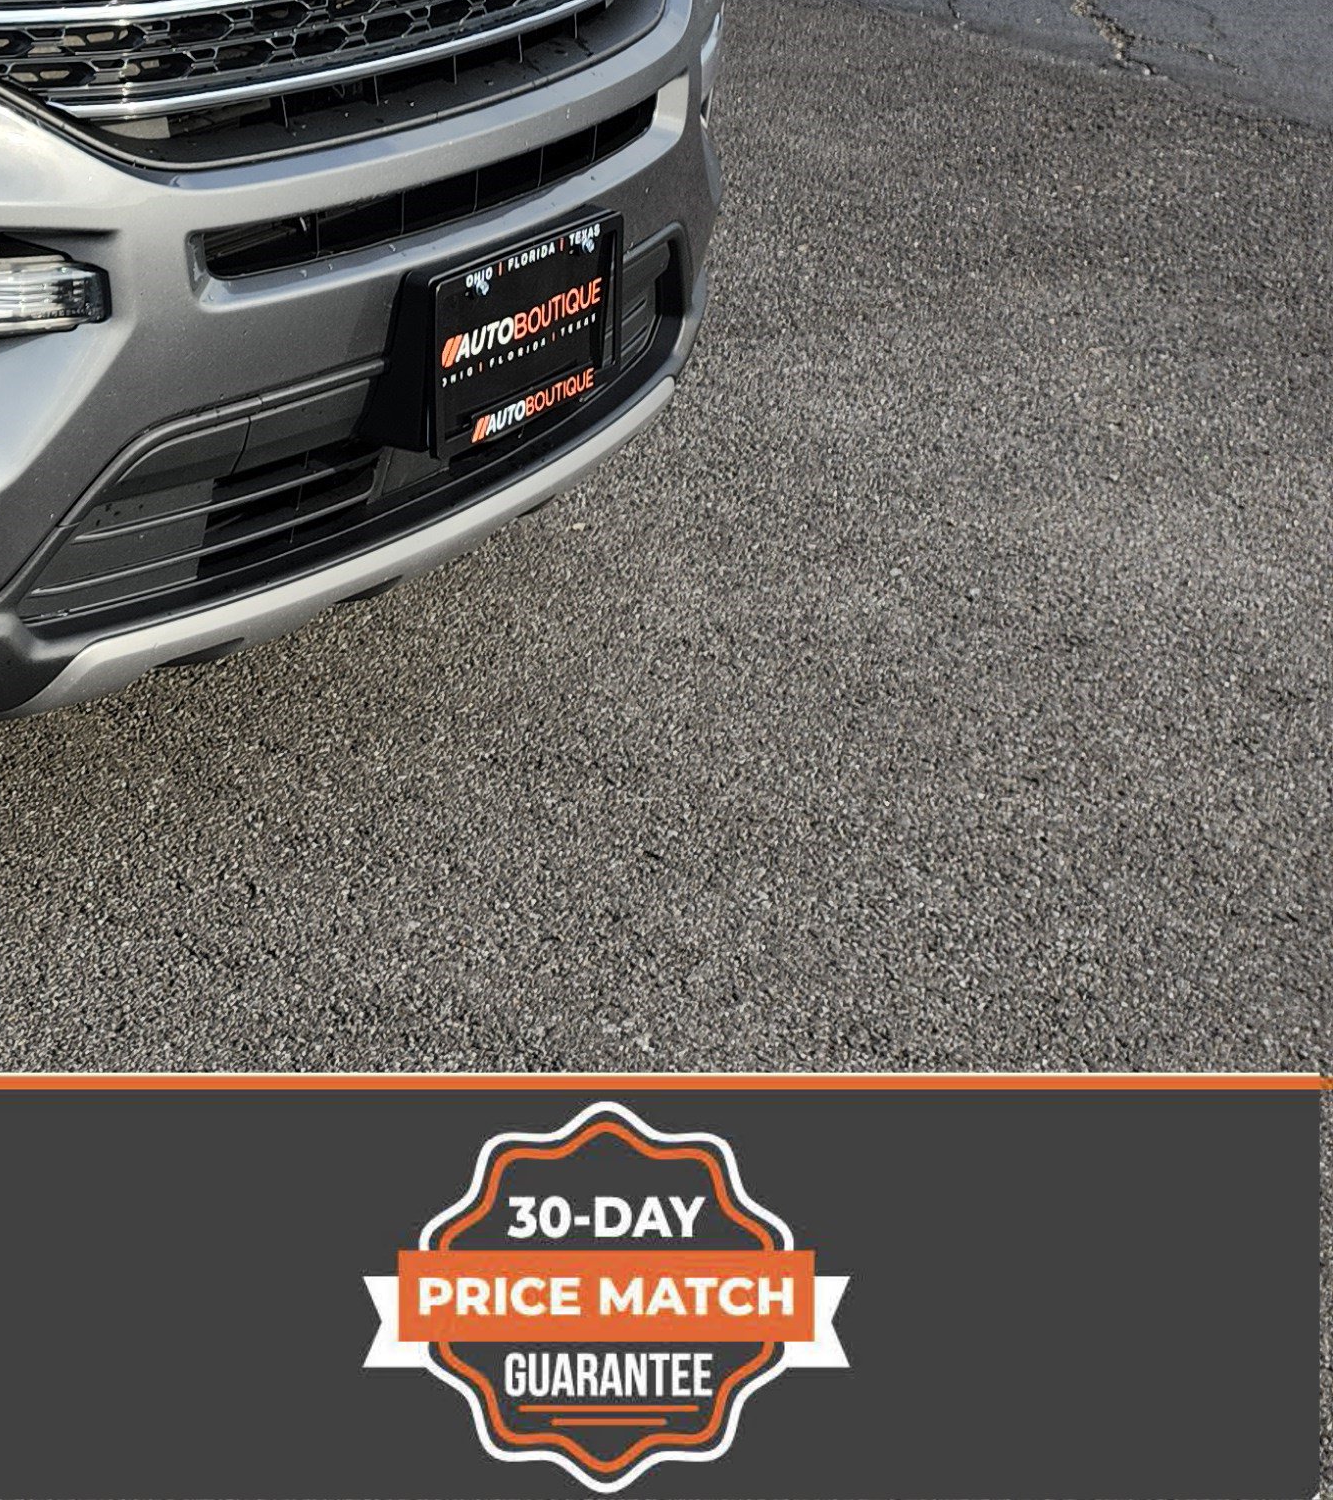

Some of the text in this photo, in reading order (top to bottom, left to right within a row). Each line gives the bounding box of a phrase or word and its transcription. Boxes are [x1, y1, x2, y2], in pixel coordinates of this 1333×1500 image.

[465, 223, 601, 288] OHIO FLORIDA TEXAS
[455, 277, 603, 363] AUTOBOUTIQUE
[485, 367, 595, 437] AUTOBOUTIQUE
